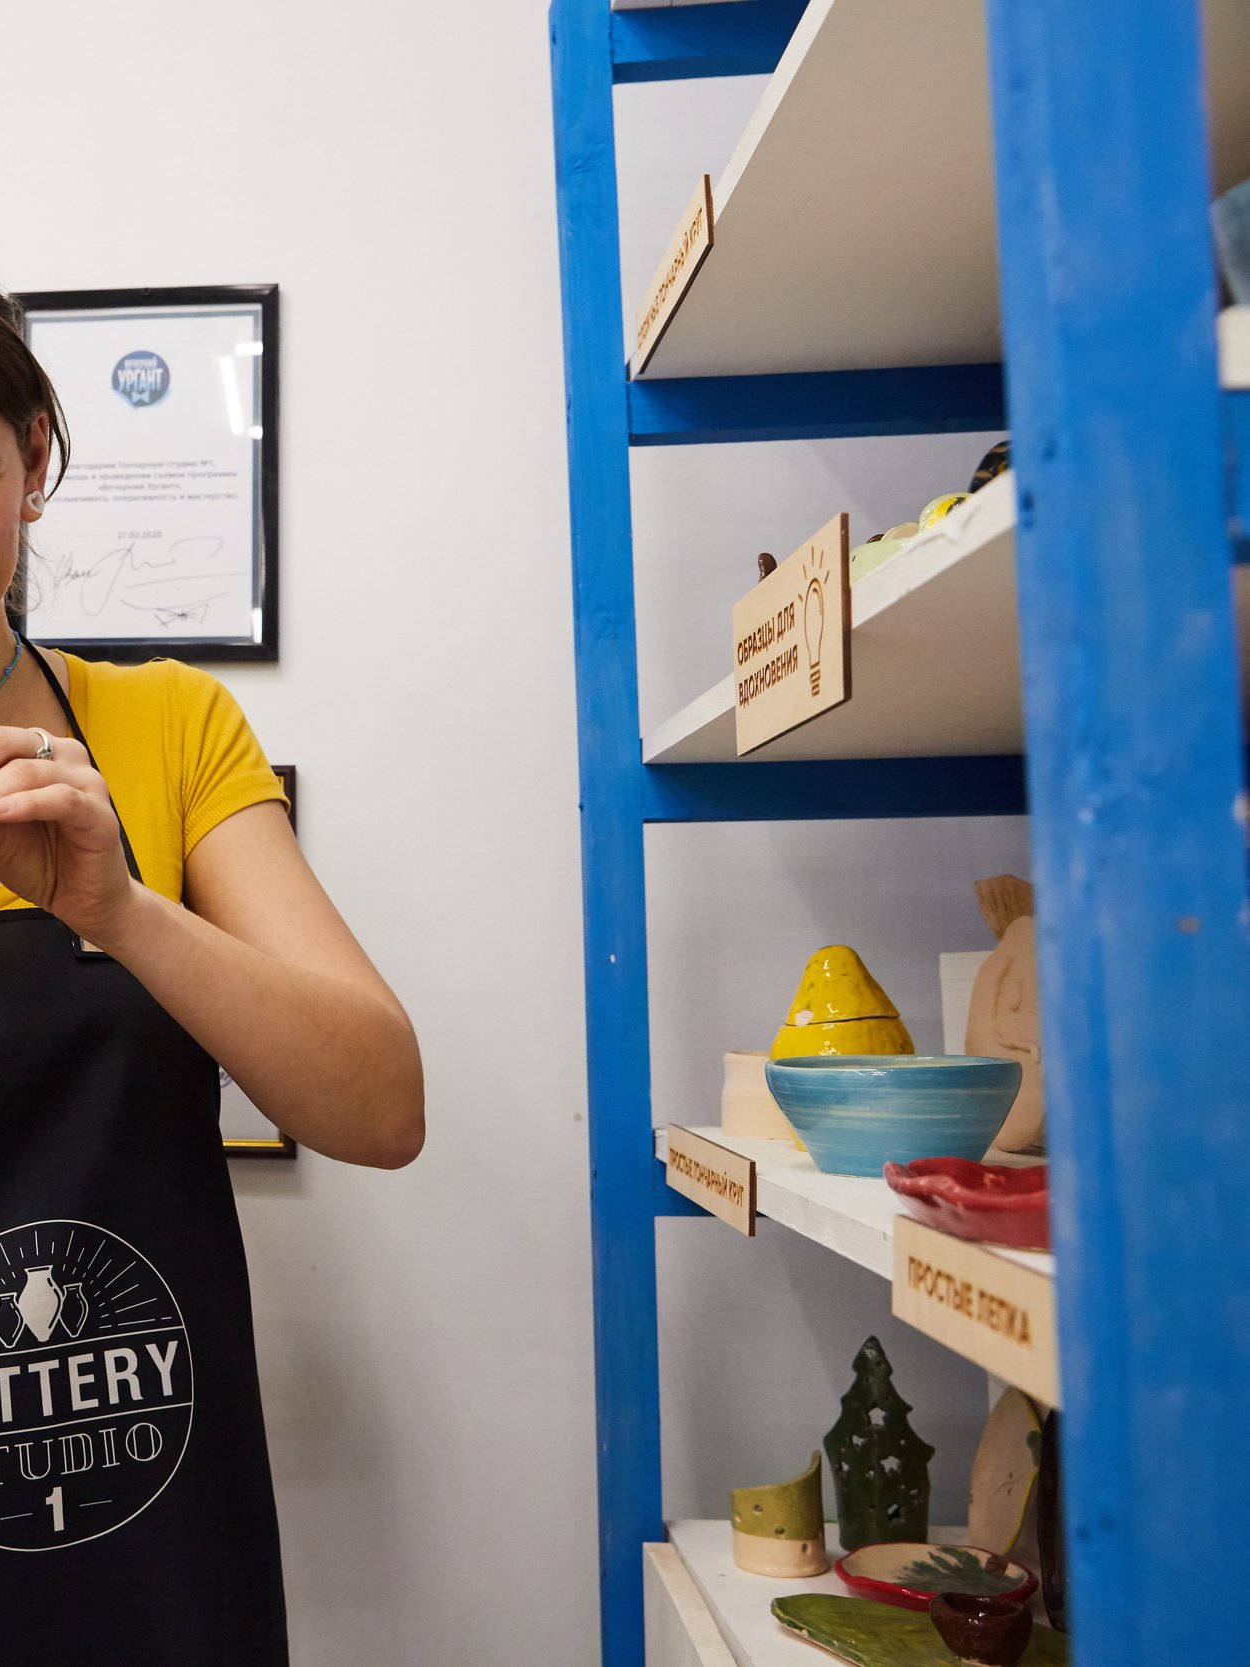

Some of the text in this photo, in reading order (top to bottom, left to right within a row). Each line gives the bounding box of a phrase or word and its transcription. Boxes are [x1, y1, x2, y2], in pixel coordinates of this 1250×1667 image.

[117, 368, 163, 392] УРГАНТ
[737, 601, 795, 667] ОБРАЗЦЫ ДЛЯ
[738, 643, 798, 709] ВДОХНОВЕНИЯ
[669, 1146, 744, 1208] ПРОСТЫЕ ГОНЧАРНЫЙ КРУГ
[907, 1255, 1033, 1349] ПРОСТЫЕ ЛЕПКА
[44, 1485, 65, 1532] 1
